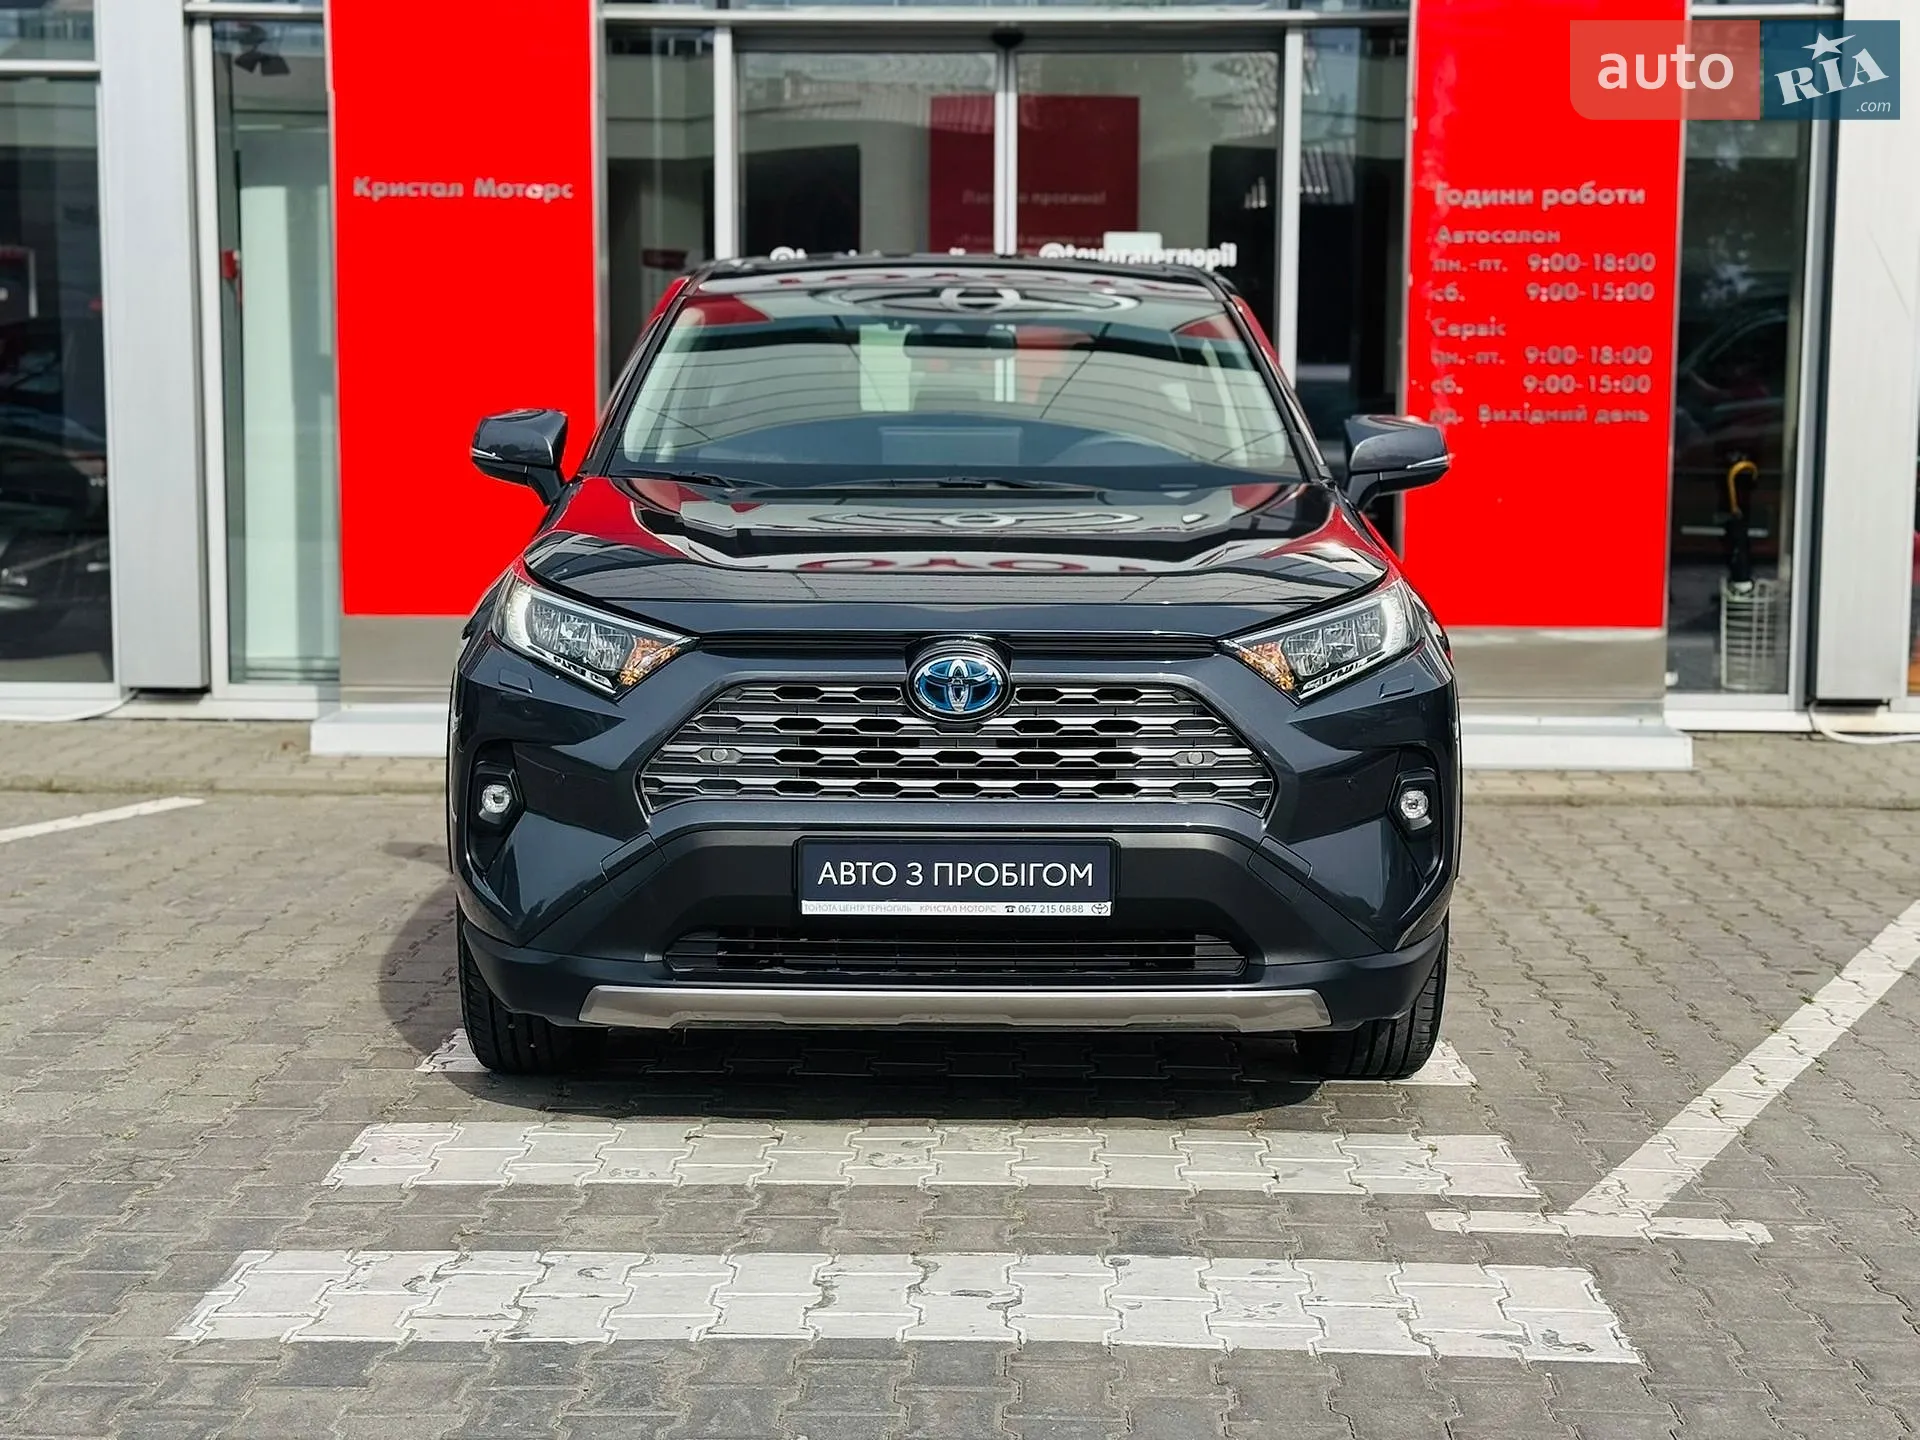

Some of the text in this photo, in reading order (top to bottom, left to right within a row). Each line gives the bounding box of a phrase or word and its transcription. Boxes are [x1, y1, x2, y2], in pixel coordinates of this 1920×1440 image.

[353, 176, 574, 204] Кристал Моторс
[1433, 181, 1646, 211] Години роботи
[1436, 226, 1561, 243] Автосалон
[1431, 282, 1466, 302] сб.
[1432, 316, 1507, 341] Сервіс
[1430, 374, 1464, 394] сб.
[1595, 409, 1650, 424] день
[817, 861, 897, 886] АВТО
[933, 863, 1094, 888] ПРОБІГОМ
[839, 904, 865, 913] ЦЕНТР
[919, 904, 957, 913] КРИСТАЛ
[959, 904, 997, 914] МОТОРС
[1018, 904, 1036, 914] 067
[1039, 904, 1056, 914] 215
[1059, 904, 1084, 914] 0888
